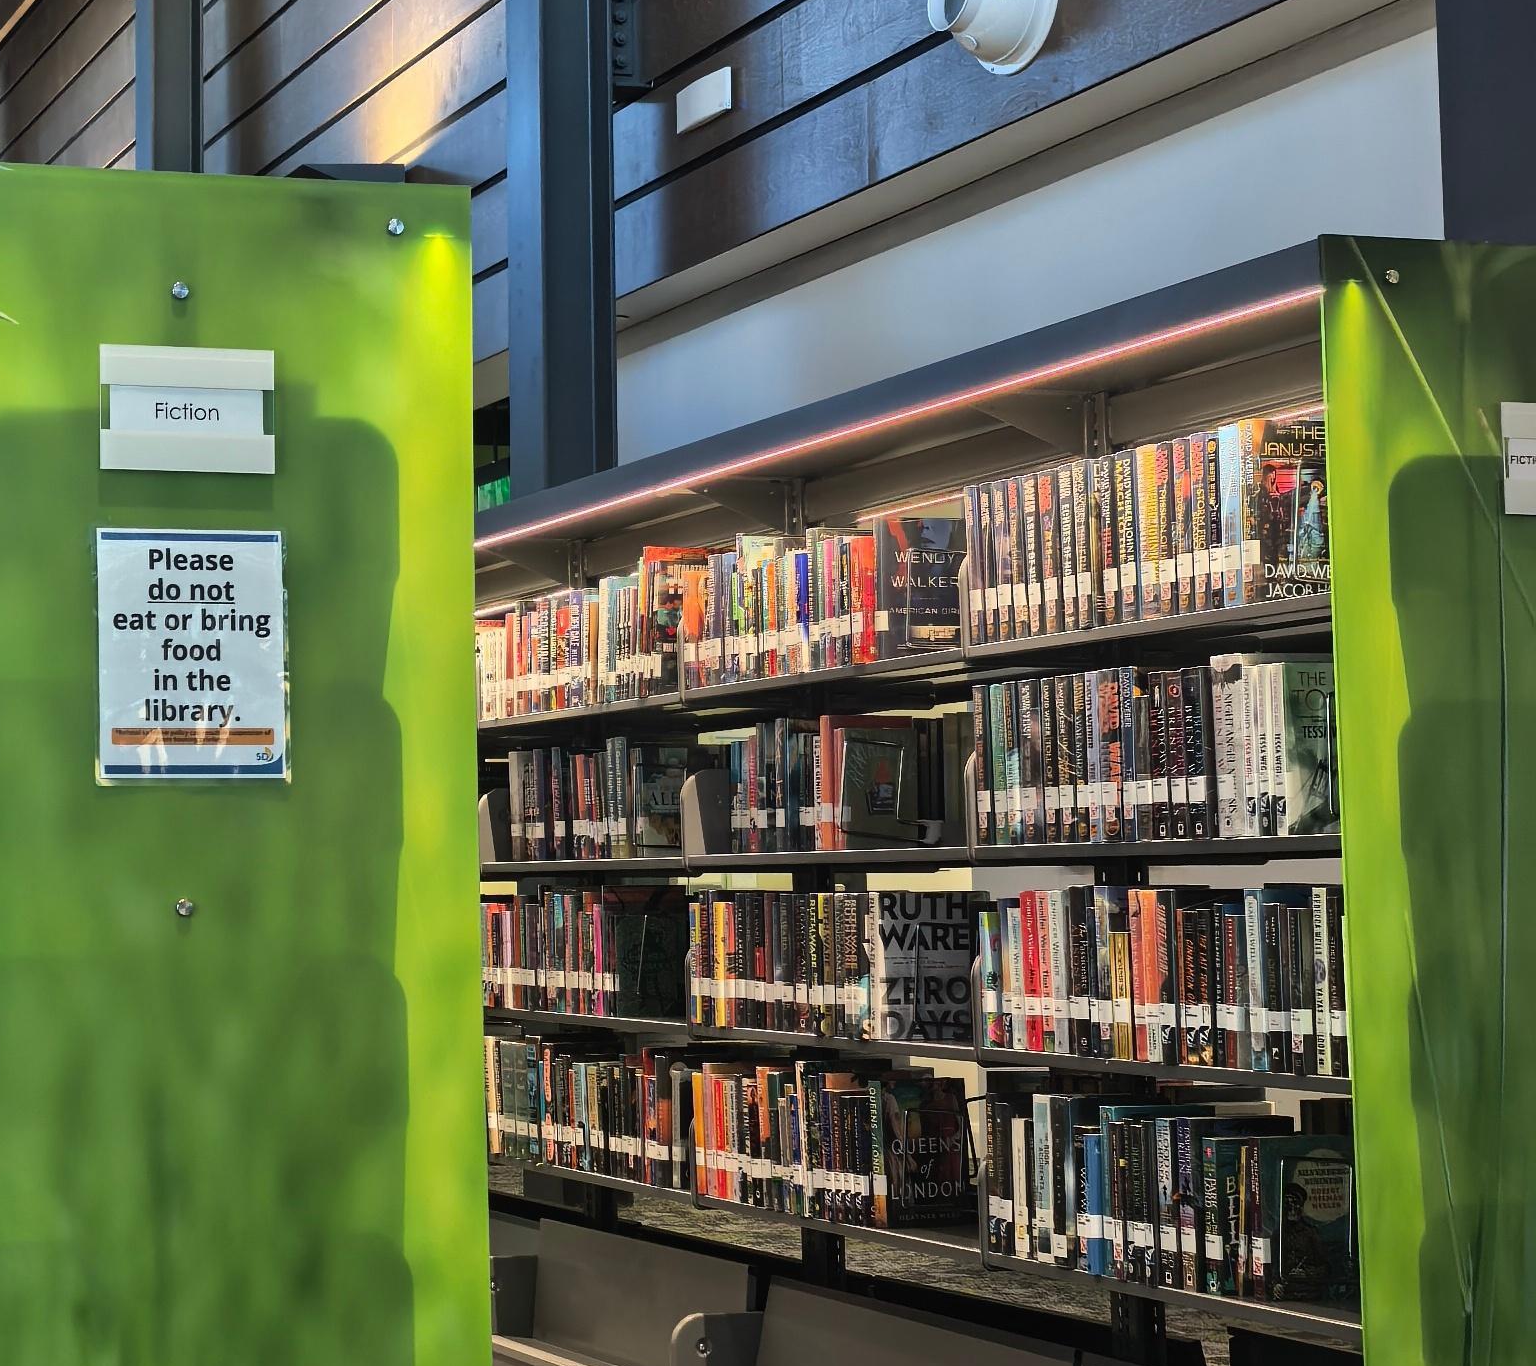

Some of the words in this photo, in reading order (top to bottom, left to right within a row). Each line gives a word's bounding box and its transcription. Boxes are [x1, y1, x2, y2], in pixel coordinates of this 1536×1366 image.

[155, 402, 219, 421] Fiction
[1291, 426, 1326, 440] THE
[1261, 442, 1314, 457] JANUS
[1123, 458, 1131, 487] DAVID
[1246, 456, 1254, 485] WEBER
[1124, 487, 1133, 522] WEBER
[1061, 503, 1070, 545] ECHOES
[1126, 527, 1134, 551] JOHN
[148, 548, 234, 571] Please
[895, 550, 955, 564] WENDY
[148, 578, 181, 601] do
[190, 581, 235, 602] not
[113, 611, 156, 630] eat
[164, 613, 192, 631] or
[201, 609, 271, 638] bring
[161, 639, 221, 661] food
[154, 669, 178, 691] in
[186, 669, 231, 692] the
[1122, 673, 1130, 697] DAVID
[1298, 671, 1326, 687] THE
[145, 699, 241, 728] library.
[1124, 700, 1132, 728] WEBER
[1224, 693, 1234, 727] NIGHT
[1185, 705, 1195, 752] BRENT
[1045, 739, 1053, 761] TOLL
[1046, 765, 1053, 777] OF
[808, 899, 817, 931] RUTH
[844, 899, 852, 932] RUTH
[879, 892, 969, 921] RUTH
[1026, 898, 1034, 933] Jennifer
[1038, 897, 1047, 930] Jennifer
[1157, 902, 1167, 940] SUNSET
[879, 923, 970, 951] WARE
[1079, 922, 1088, 937] The
[809, 934, 817, 968] WARE
[824, 934, 832, 969] WARE
[1027, 933, 1035, 966] Weiner
[1040, 933, 1048, 966] Weiner
[1052, 941, 1061, 977] WEINER
[1158, 940, 1169, 977] EMPIRE
[1042, 969, 1050, 989] That
[1079, 940, 1089, 989] Passionate
[1186, 939, 1194, 990] CINNAMON
[880, 976, 971, 1005] ZERO
[880, 1009, 972, 1042] DAYS
[868, 1087, 878, 1129] QUEENS
[871, 1144, 882, 1175] LOND
[891, 1138, 962, 1156] QUEENS
[920, 1159, 935, 1180] of
[1037, 1146, 1045, 1190] ACCIDENTS
[891, 1181, 966, 1201] LONDON
